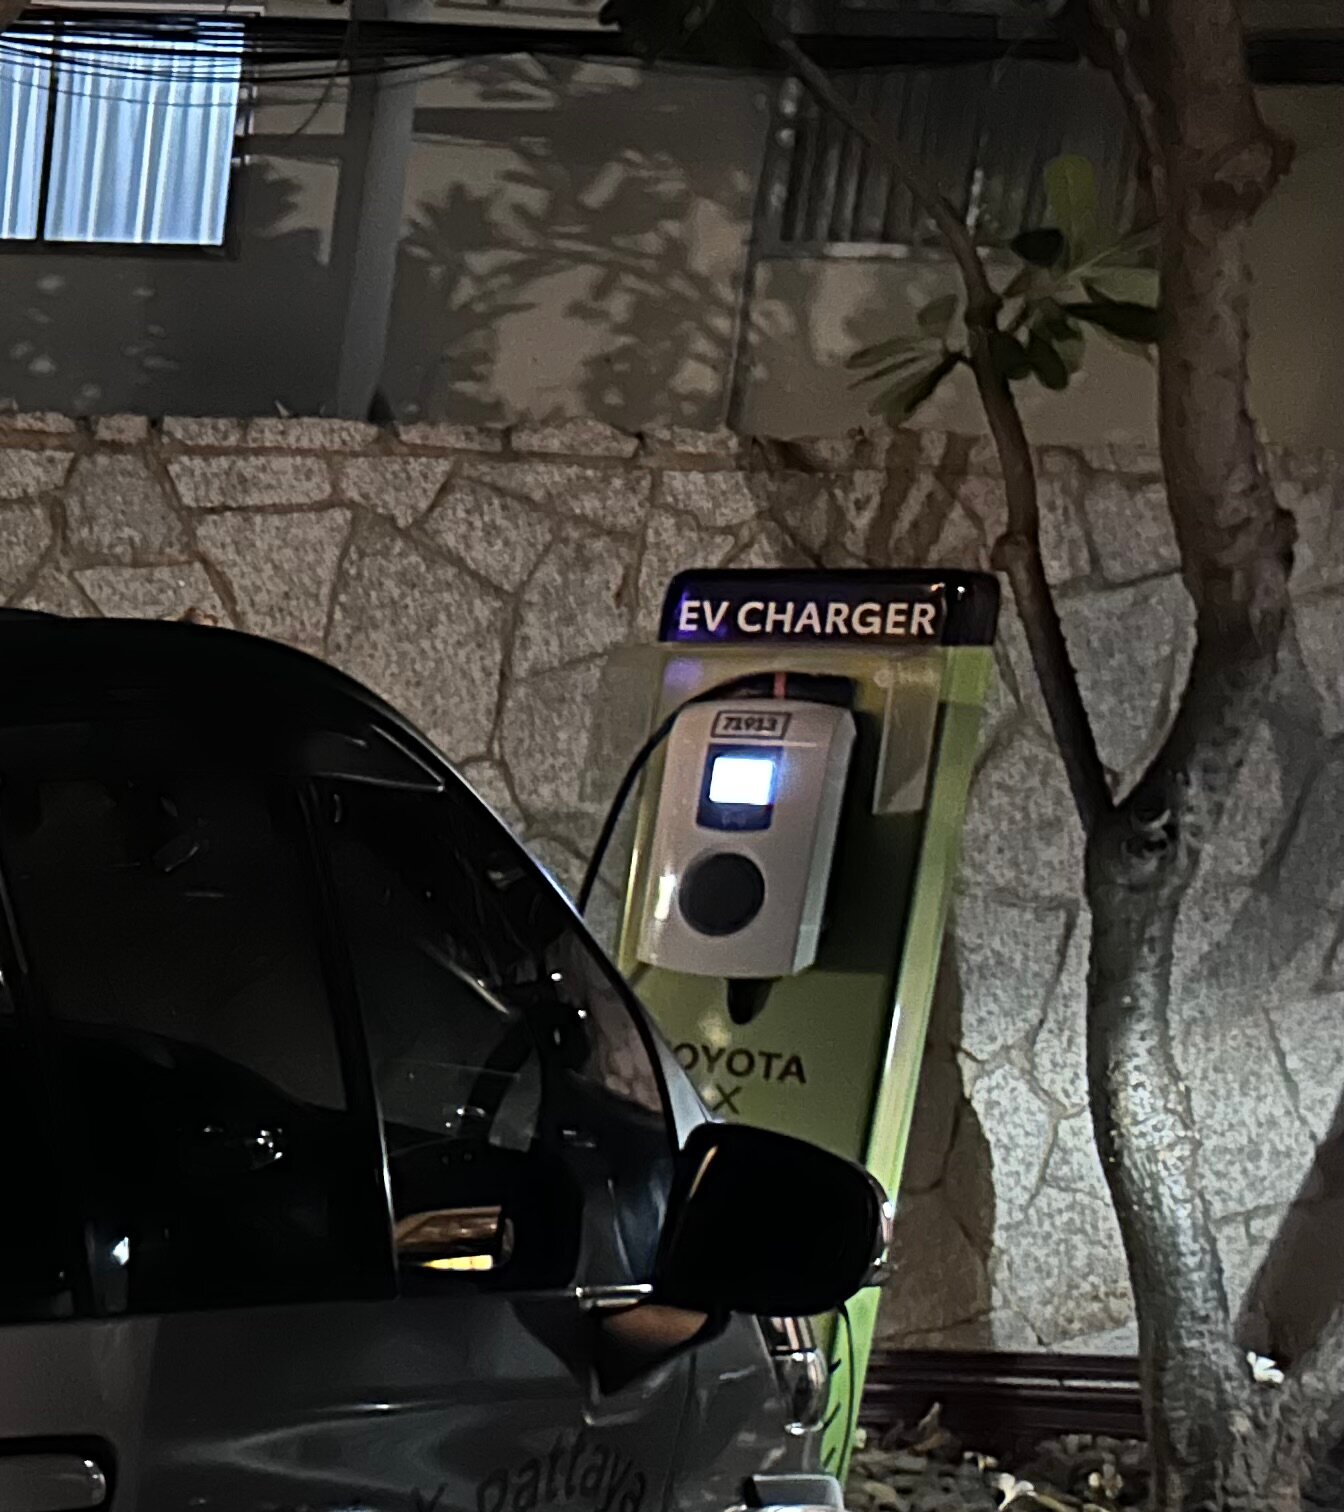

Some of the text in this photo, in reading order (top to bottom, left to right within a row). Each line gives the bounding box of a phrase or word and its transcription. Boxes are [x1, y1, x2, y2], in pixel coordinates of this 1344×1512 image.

[678, 600, 936, 635] EV CHARGER
[673, 1043, 807, 1084] OYOTA
[712, 1083, 742, 1115] X
